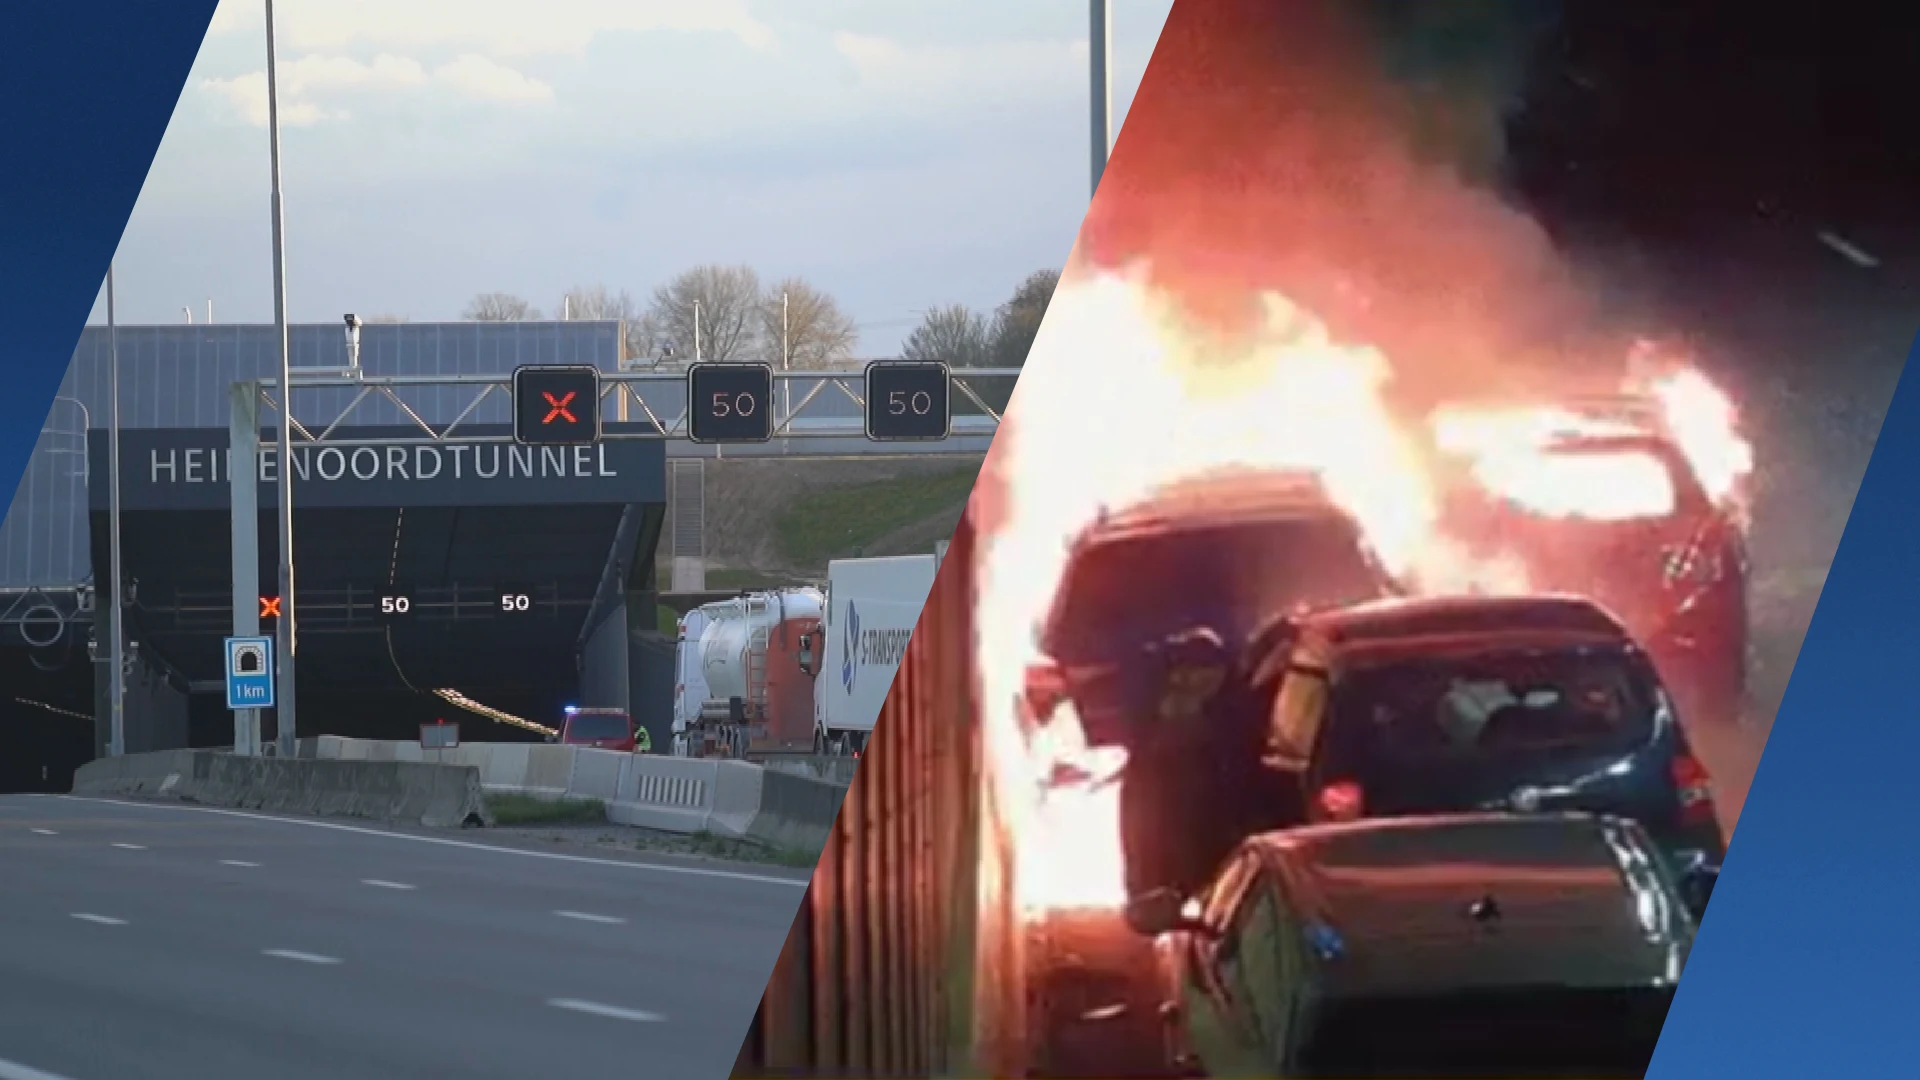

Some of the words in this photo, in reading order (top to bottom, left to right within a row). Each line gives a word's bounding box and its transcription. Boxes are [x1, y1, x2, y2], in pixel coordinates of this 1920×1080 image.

[711, 391, 756, 418] 50
[888, 390, 932, 416] 50
[151, 443, 617, 483] HEIENOORDTUNNEL
[381, 596, 410, 613] 50
[501, 594, 530, 611] 50
[236, 683, 241, 699] 1
[244, 683, 265, 699] km
